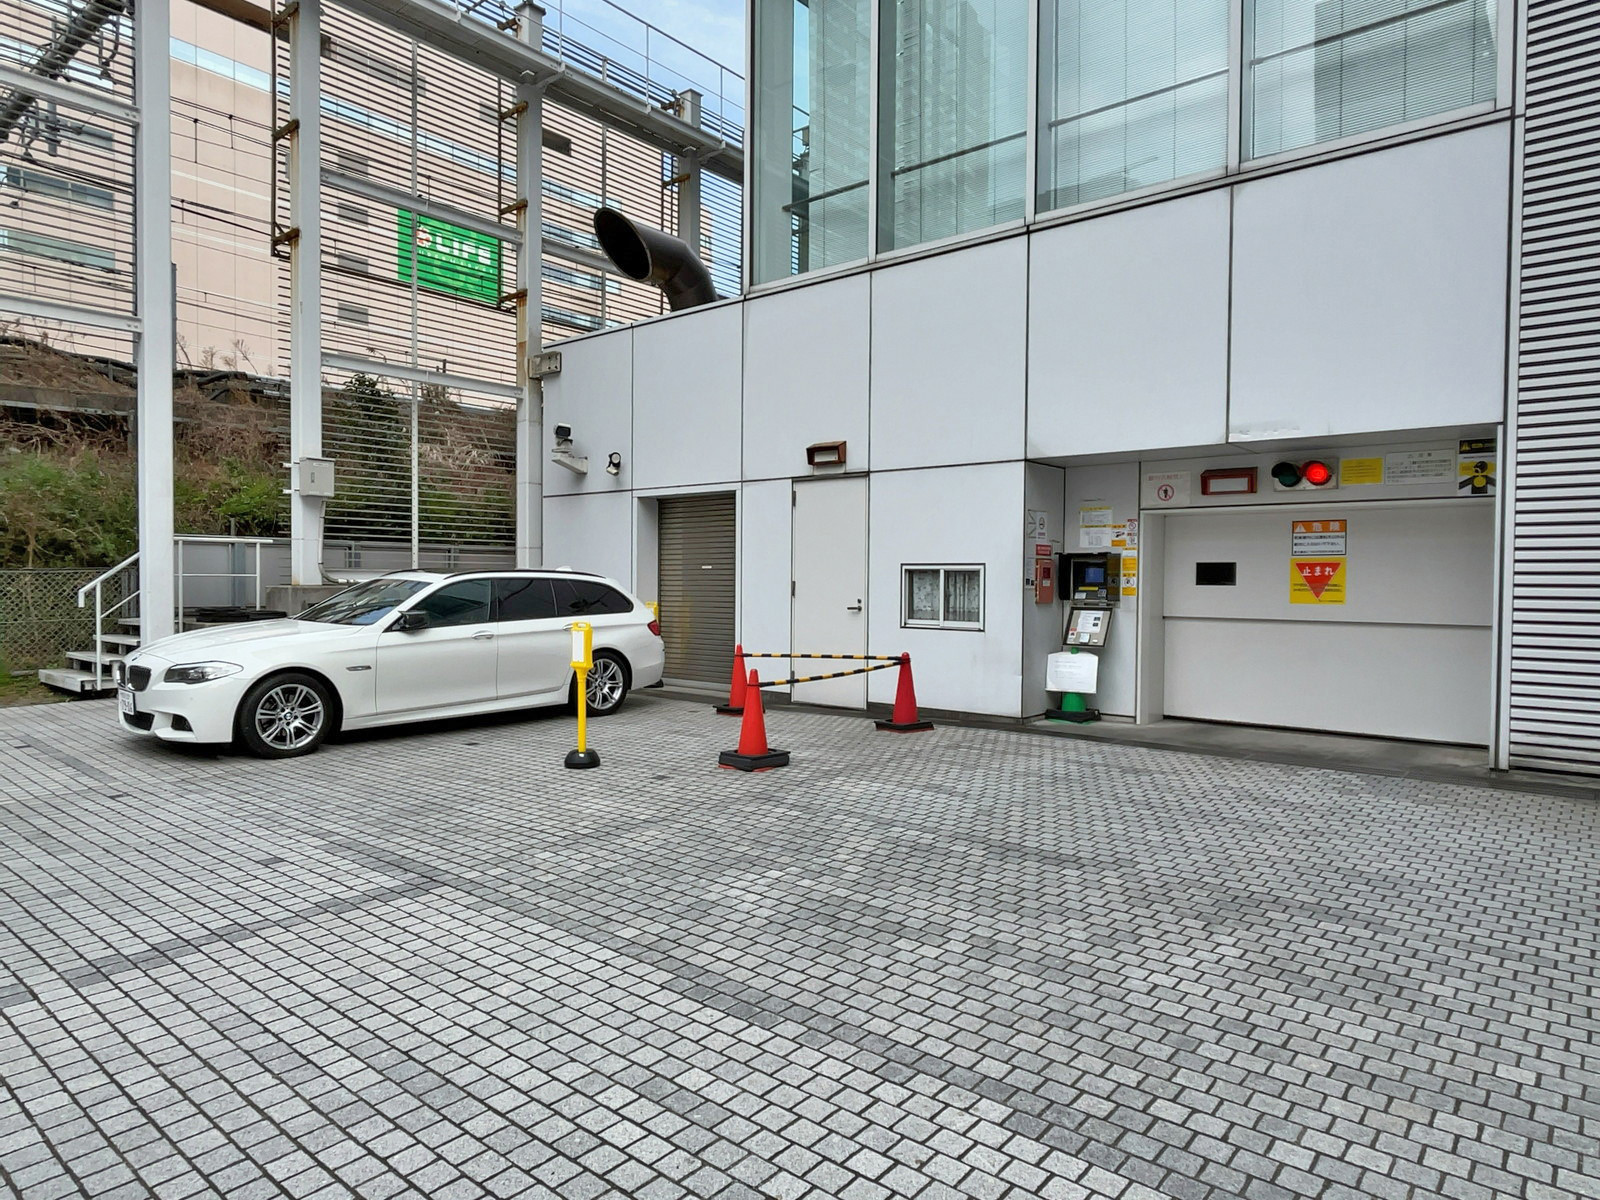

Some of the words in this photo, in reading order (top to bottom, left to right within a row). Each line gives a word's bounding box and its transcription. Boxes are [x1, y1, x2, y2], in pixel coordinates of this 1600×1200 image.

[435, 233, 491, 266] LIFE
[1301, 566, 1335, 576] 止まれ
